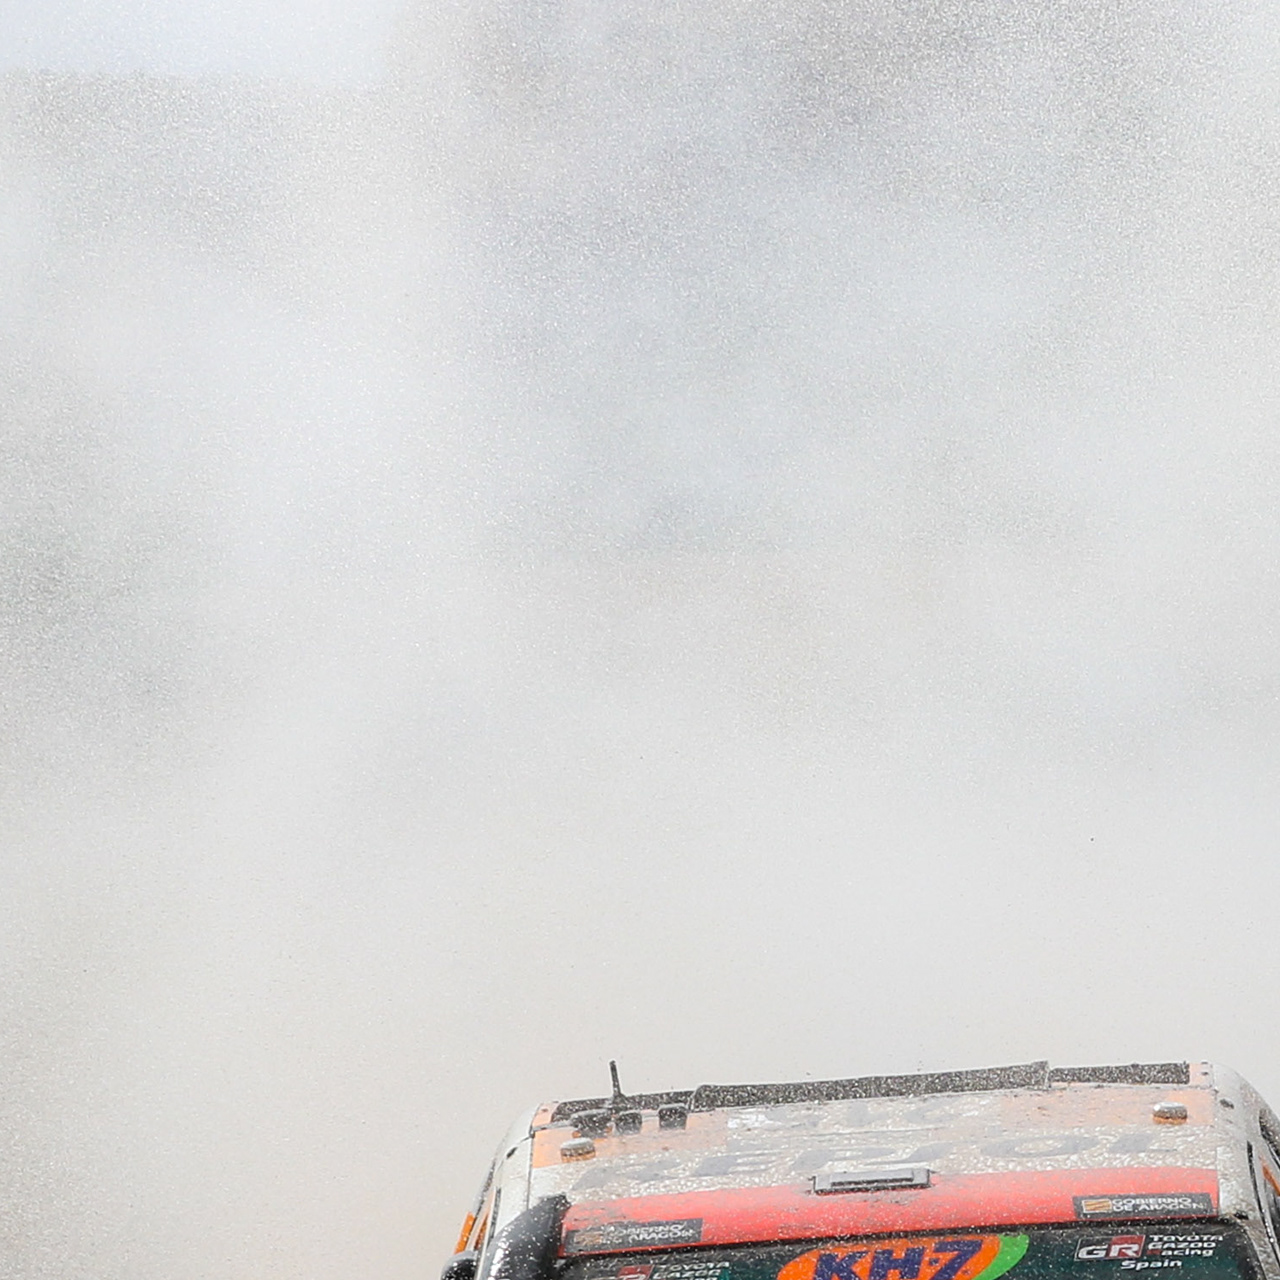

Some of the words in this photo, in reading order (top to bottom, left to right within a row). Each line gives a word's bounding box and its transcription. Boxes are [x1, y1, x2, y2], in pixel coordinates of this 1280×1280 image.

[1149, 1233, 1224, 1243] TOYOTA
[1078, 1243, 1140, 1259] GR
[1147, 1241, 1217, 1250] GAZOO
[1121, 1259, 1183, 1271] Spain
